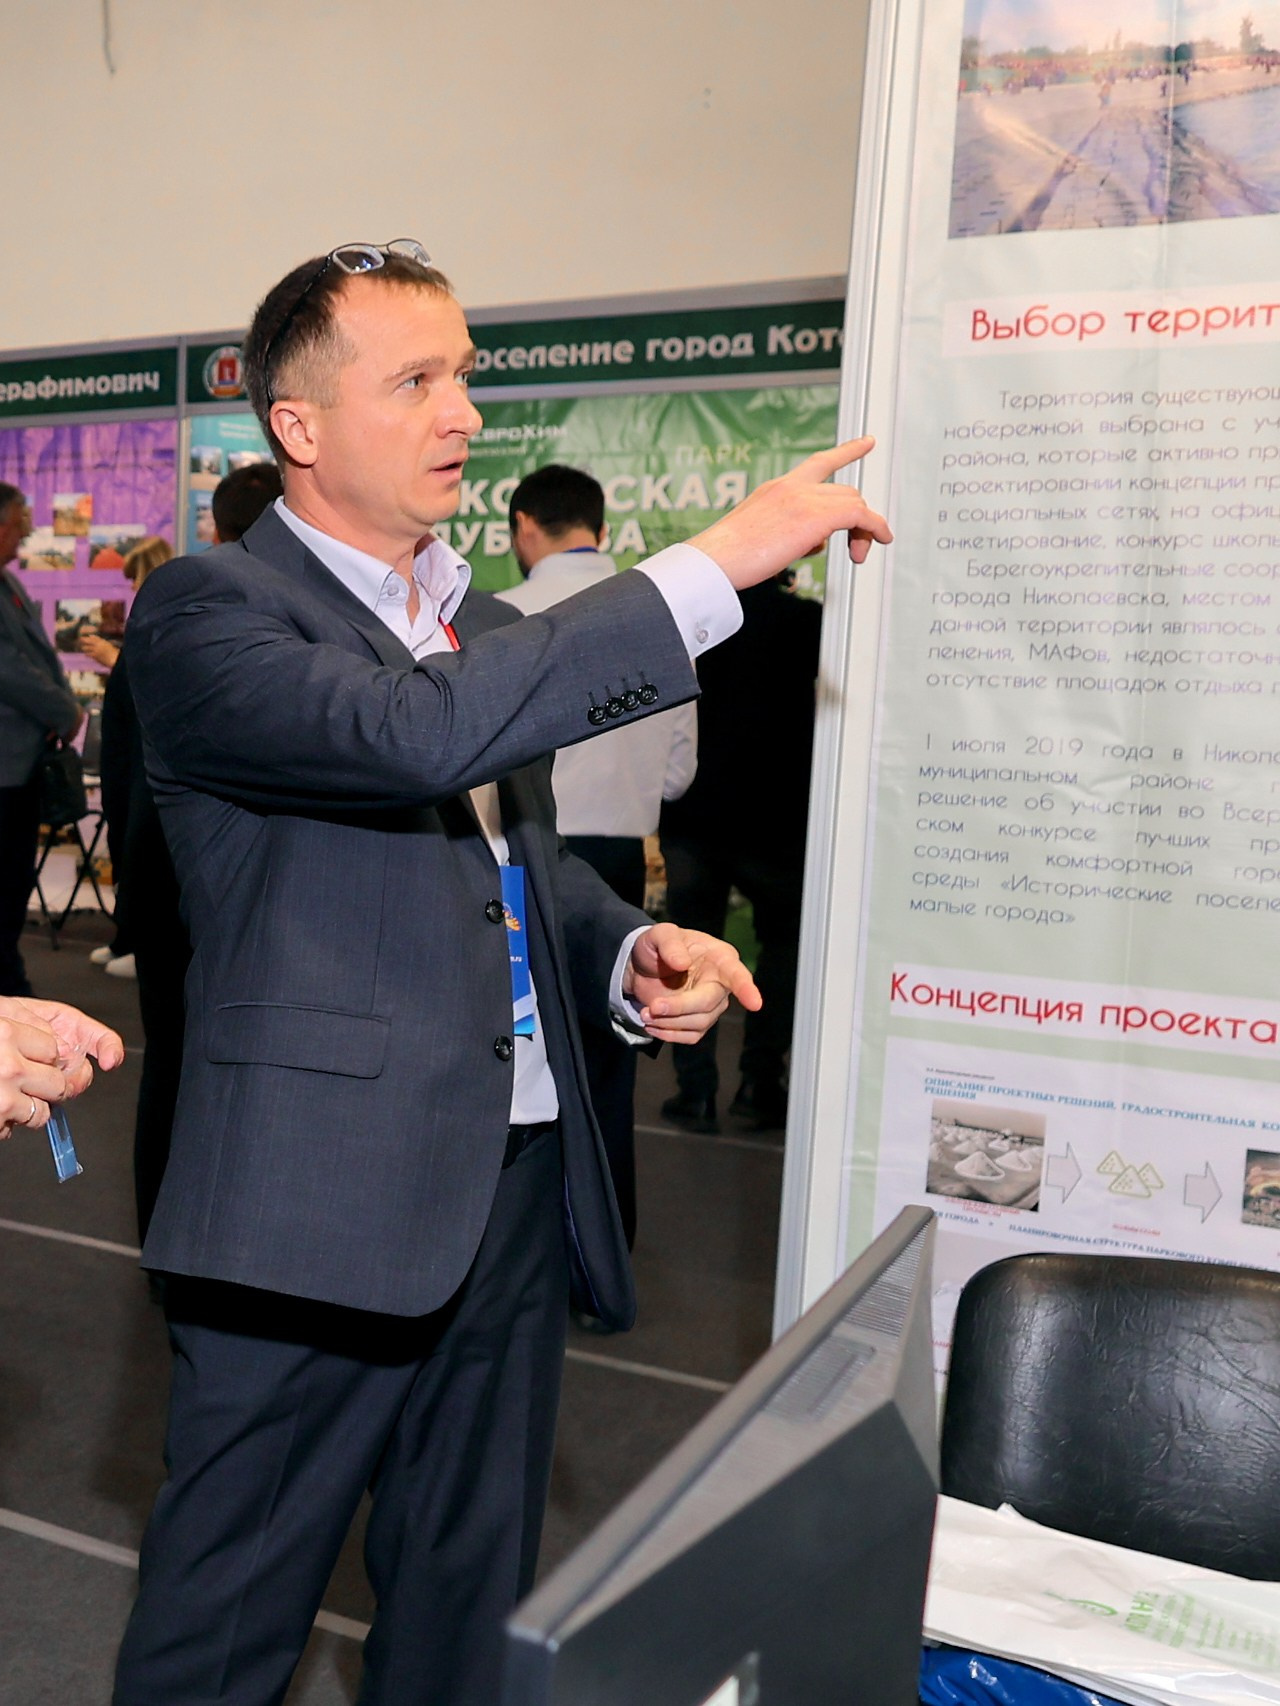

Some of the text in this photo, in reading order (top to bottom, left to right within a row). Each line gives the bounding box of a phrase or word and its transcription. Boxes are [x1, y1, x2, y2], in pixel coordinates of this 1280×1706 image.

[971, 304, 1106, 341] Выбор
[645, 335, 754, 362] город
[999, 389, 1134, 411] Территория
[944, 418, 1083, 440] набережной
[1099, 414, 1204, 436] выбрана
[1222, 416, 1238, 431] с
[942, 451, 1029, 470] района,
[1038, 448, 1137, 466] которые
[1147, 446, 1239, 463] активно
[939, 477, 1122, 498] проектировании
[1129, 475, 1246, 492] концепции
[937, 509, 949, 523] в
[956, 506, 1087, 525] социальных
[1170, 503, 1201, 519] на
[1115, 533, 1204, 551] конкурс
[967, 558, 1216, 580] Берегоукрепительные
[931, 586, 1271, 608] города Николаевска, местом
[928, 616, 1266, 637] данной территории являлось
[1028, 641, 1111, 663] МАФов,
[926, 672, 1048, 691] отсутствие
[1056, 676, 1167, 695] площадок
[1175, 678, 1263, 696] отдыха
[951, 738, 1007, 754] июля
[1024, 735, 1084, 757] 2019
[1101, 744, 1154, 763] года
[1173, 748, 1184, 761] в
[918, 765, 1078, 785] муниципальном
[1129, 773, 1214, 791] районе
[917, 790, 1008, 808] решение
[1024, 792, 1055, 811] об
[1070, 799, 1162, 817] участии
[1177, 804, 1205, 820] во
[915, 817, 965, 833] ском
[998, 823, 1097, 843] конкурсе
[1135, 830, 1211, 849] лучших
[913, 844, 1280, 884] создания комфортной гор
[911, 870, 980, 891] среды
[1000, 873, 1173, 904] «Исторические
[909, 898, 1076, 926] малые города»
[889, 971, 1278, 1044] Концепция проекта
[924, 1086, 977, 1101] РЕШЕНИЯ
[924, 1076, 986, 1093] ОПИСАНИЕ
[988, 1084, 1056, 1102] ПРОЕКТНЫХ
[1121, 1101, 1257, 1129] ГРАДОСТРОИТЕЛЬНАЯ
